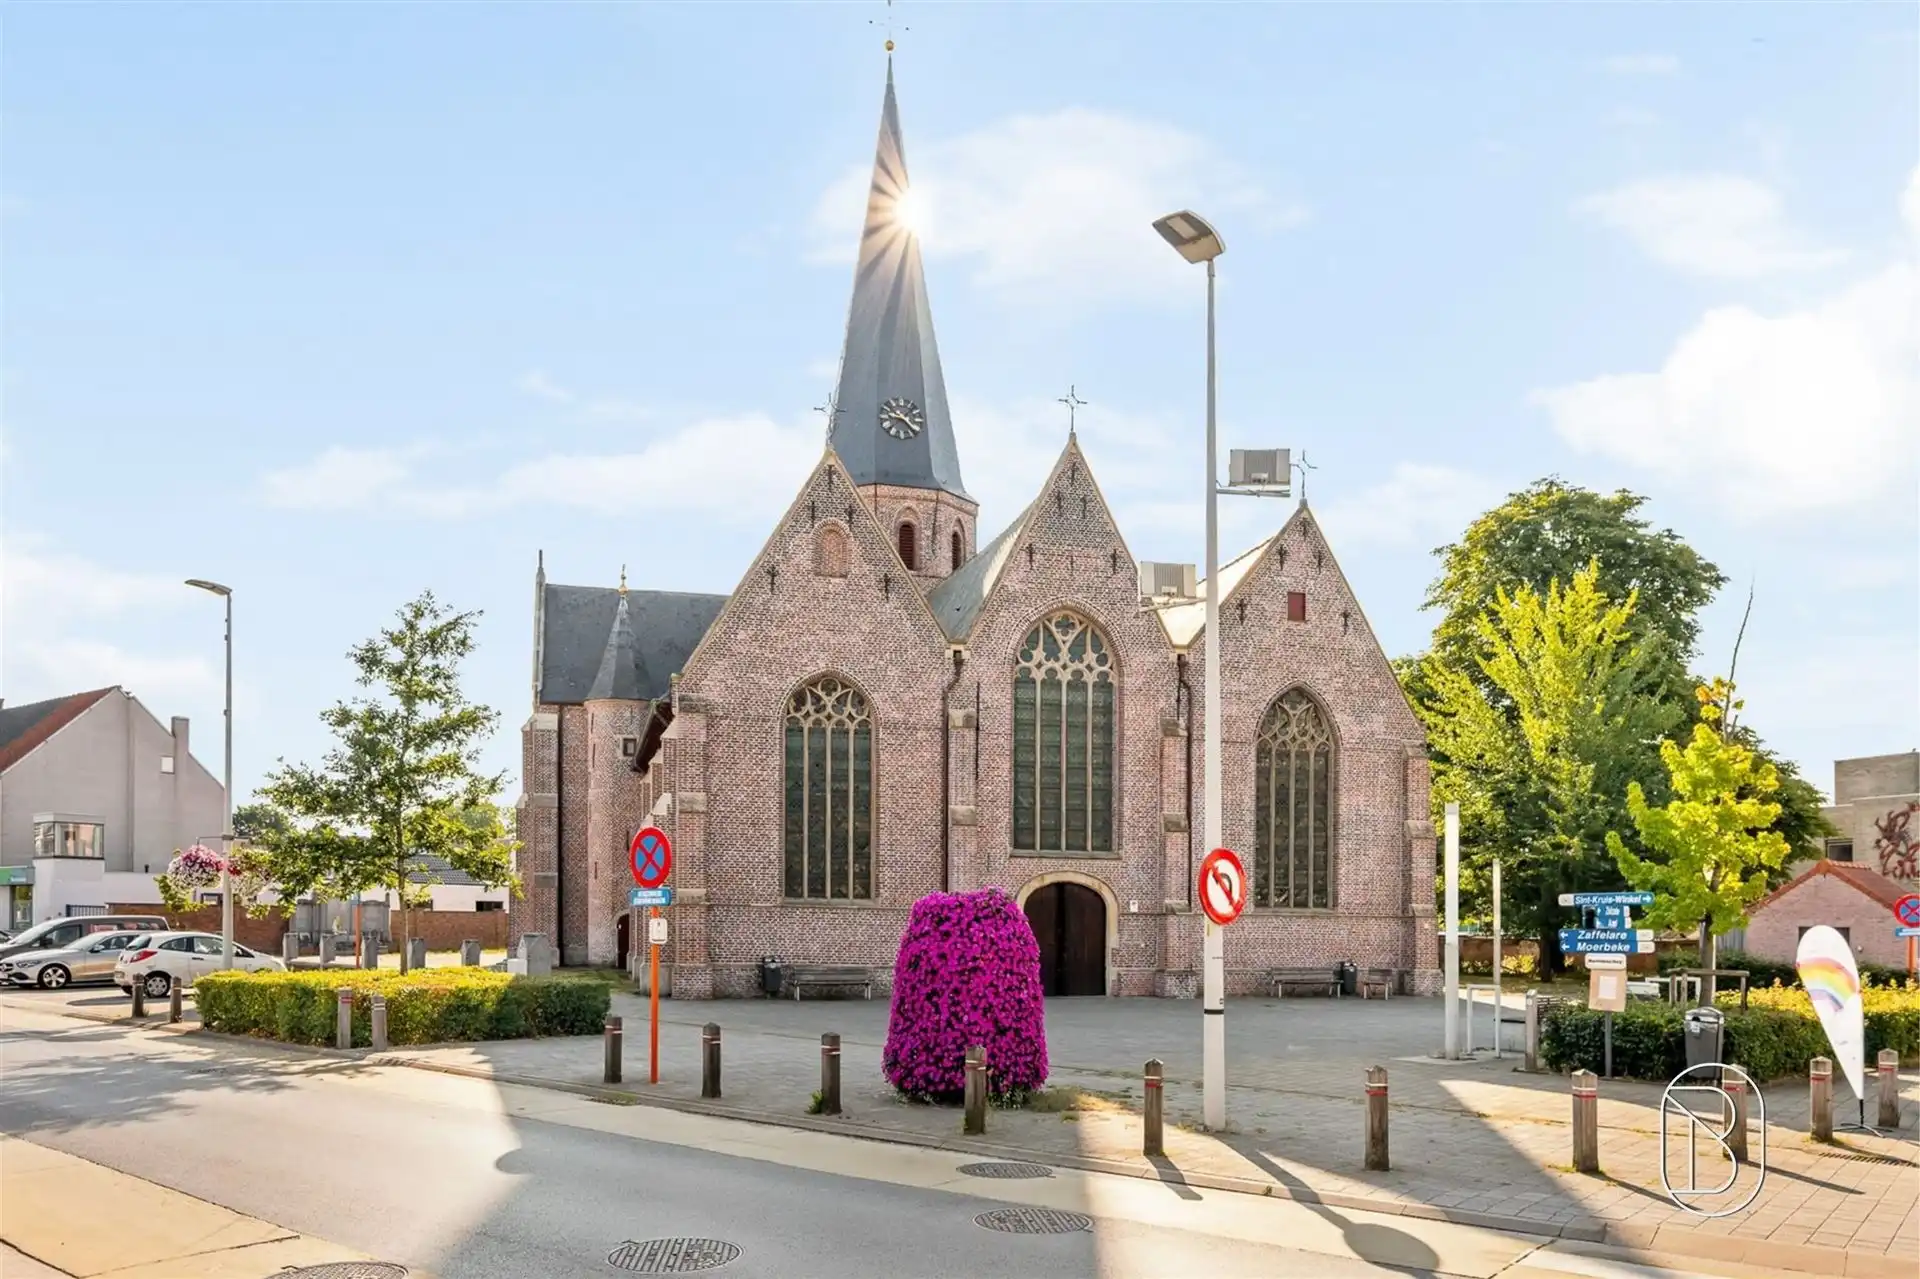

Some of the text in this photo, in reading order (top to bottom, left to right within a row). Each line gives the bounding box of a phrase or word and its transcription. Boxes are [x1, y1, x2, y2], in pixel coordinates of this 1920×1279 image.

[1575, 895, 1642, 904] Sint-Kruis-Winkel
[1577, 930, 1628, 940] Zaffelare
[1576, 942, 1631, 952] Moerbeke
